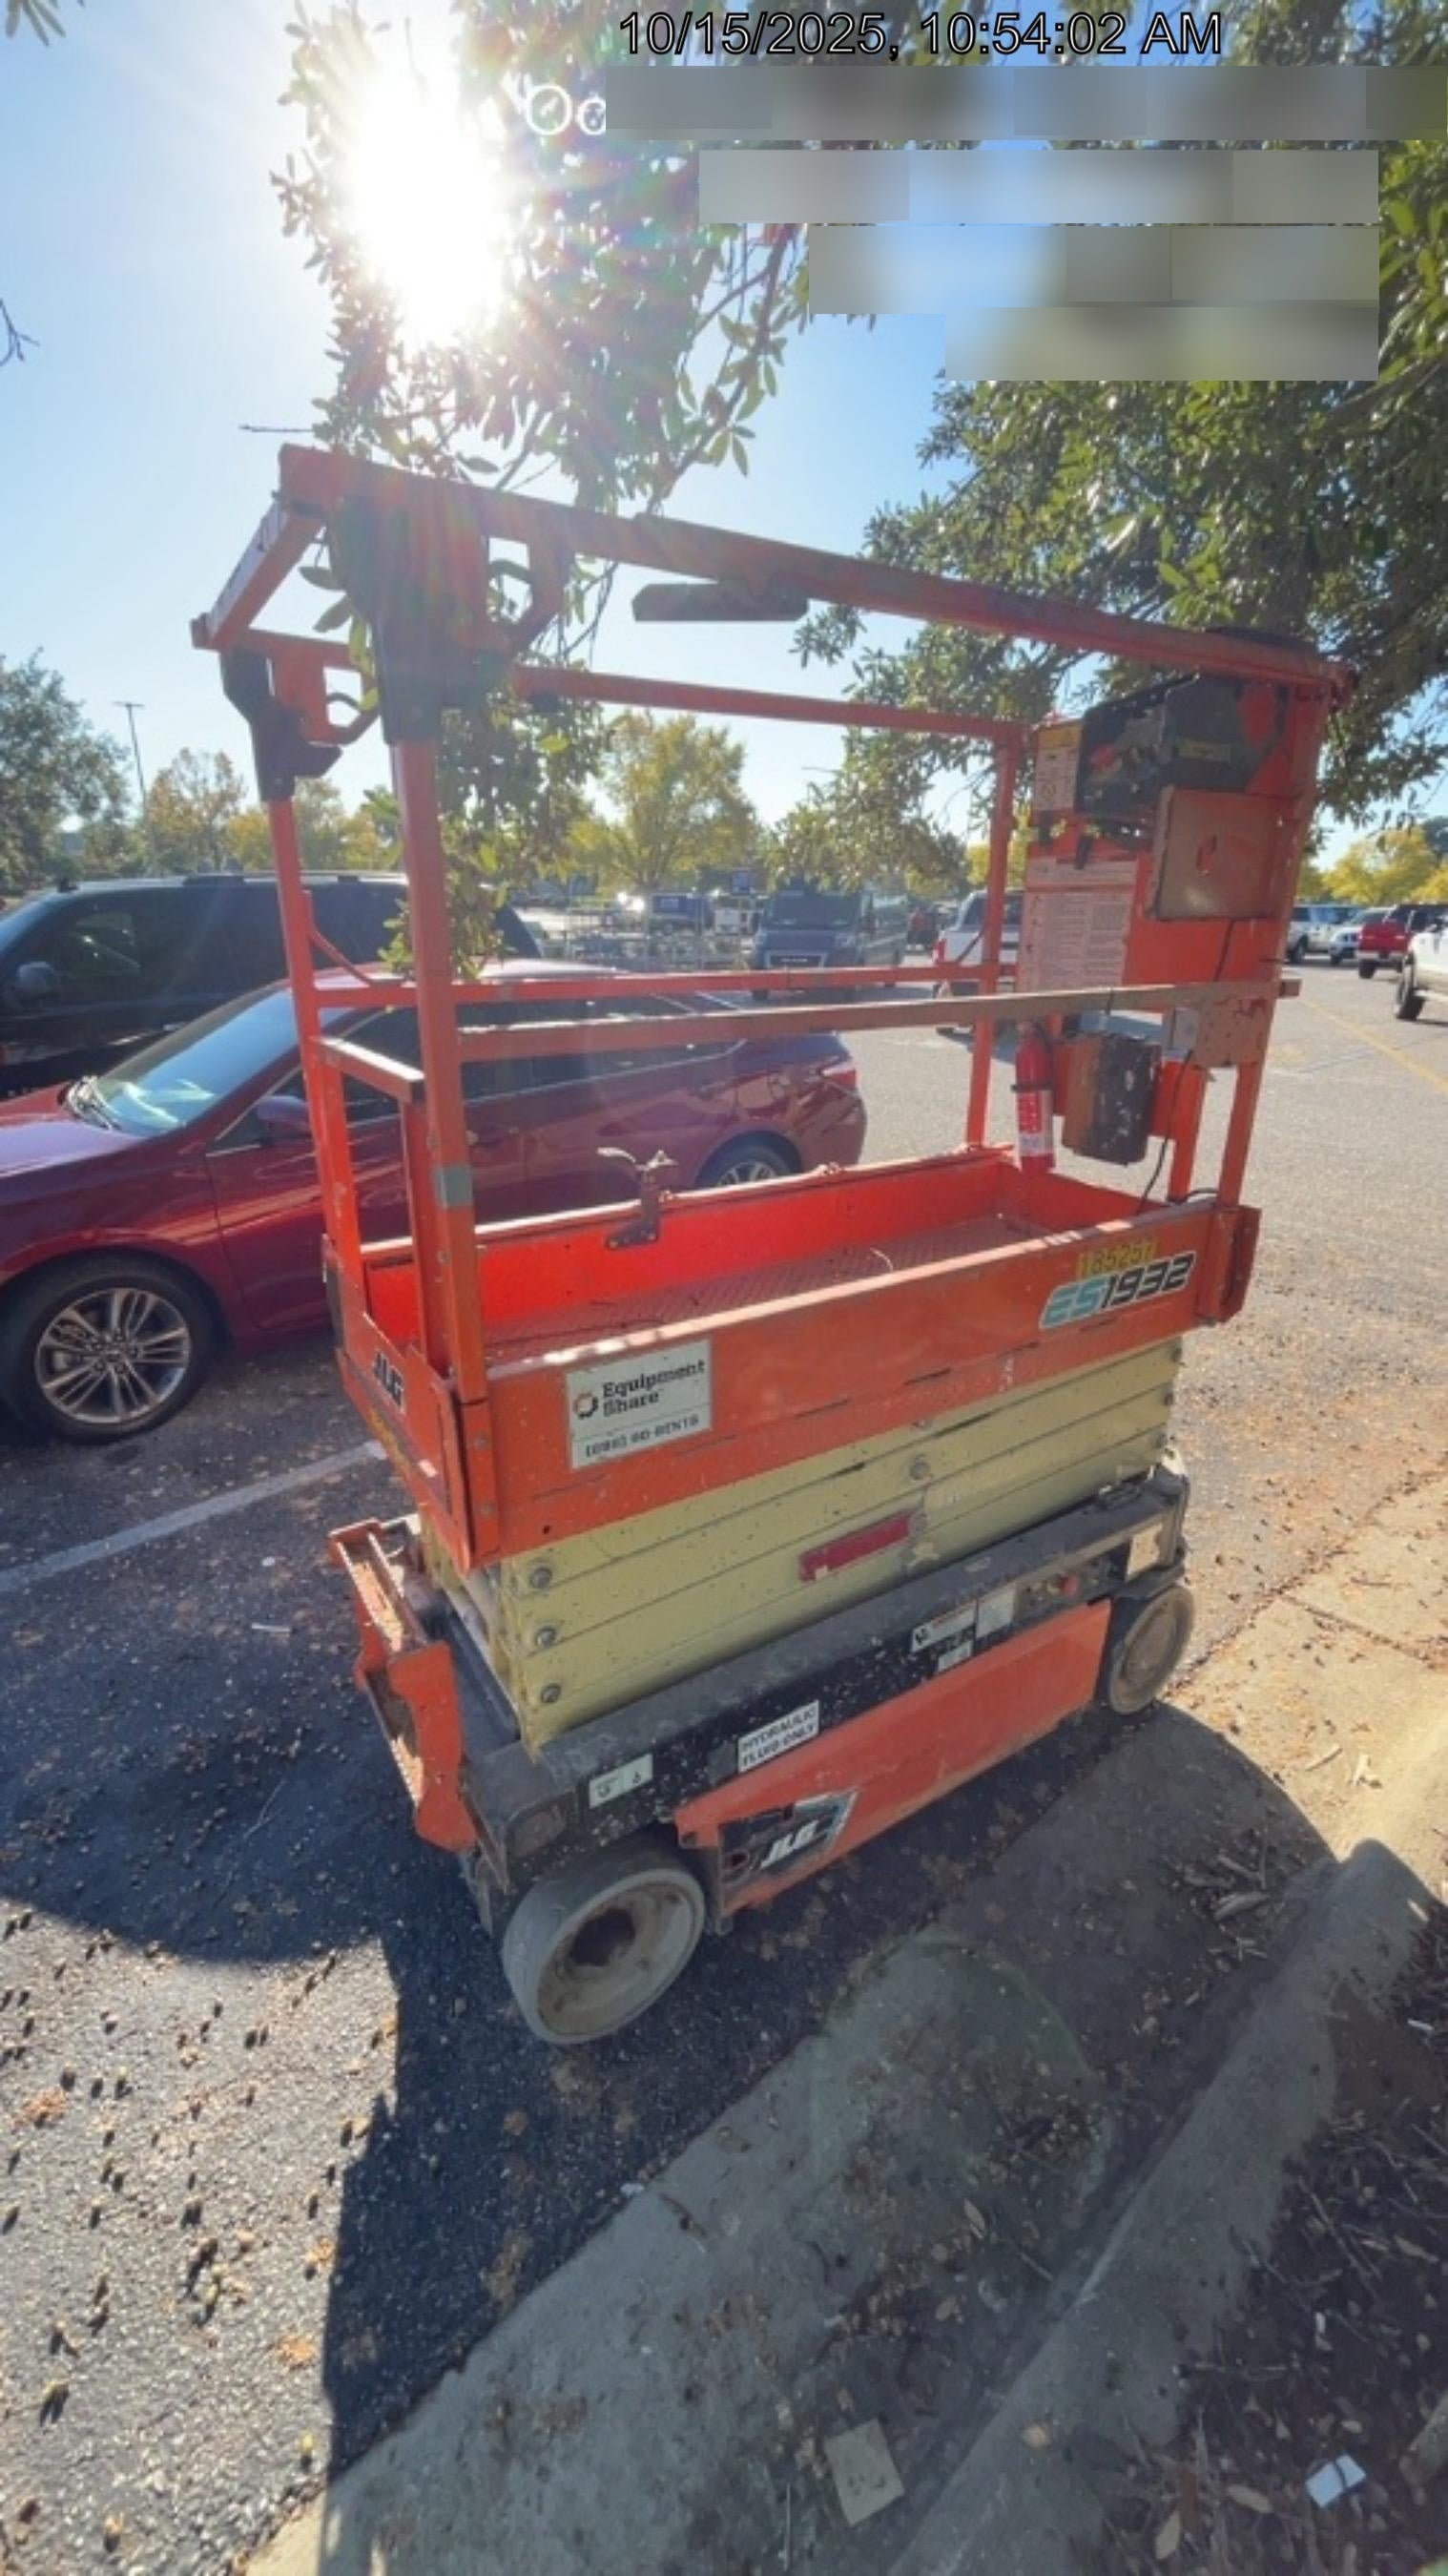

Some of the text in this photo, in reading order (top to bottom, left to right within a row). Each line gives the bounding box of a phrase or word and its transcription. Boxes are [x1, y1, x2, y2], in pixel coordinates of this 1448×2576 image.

[1041, 1251, 1195, 1327] ES1932
[602, 1359, 705, 1400] Equipment
[603, 1390, 660, 1418] Share
